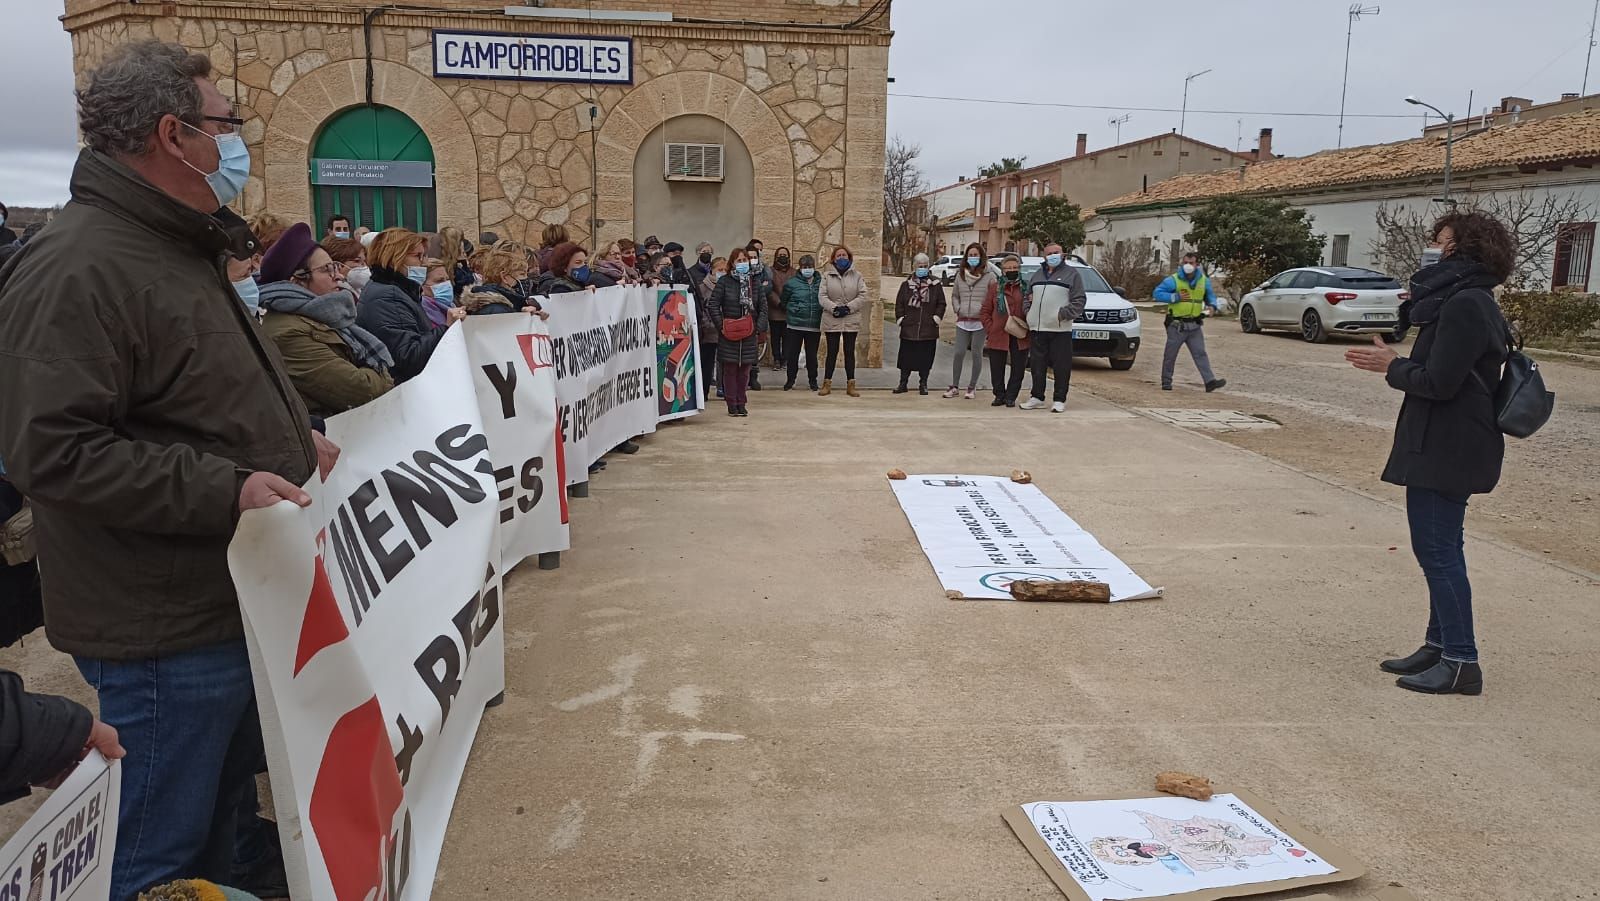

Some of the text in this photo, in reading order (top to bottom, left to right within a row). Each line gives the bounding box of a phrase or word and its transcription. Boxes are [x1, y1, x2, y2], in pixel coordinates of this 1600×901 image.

[444, 40, 621, 74] CAMPORROBLES
[643, 366, 654, 398] EL
[329, 361, 517, 628] MENOS Y
[988, 553, 1011, 566] PER
[52, 791, 101, 860] CON EL
[1040, 825, 1054, 841] TREN
[50, 823, 98, 901] TREN
